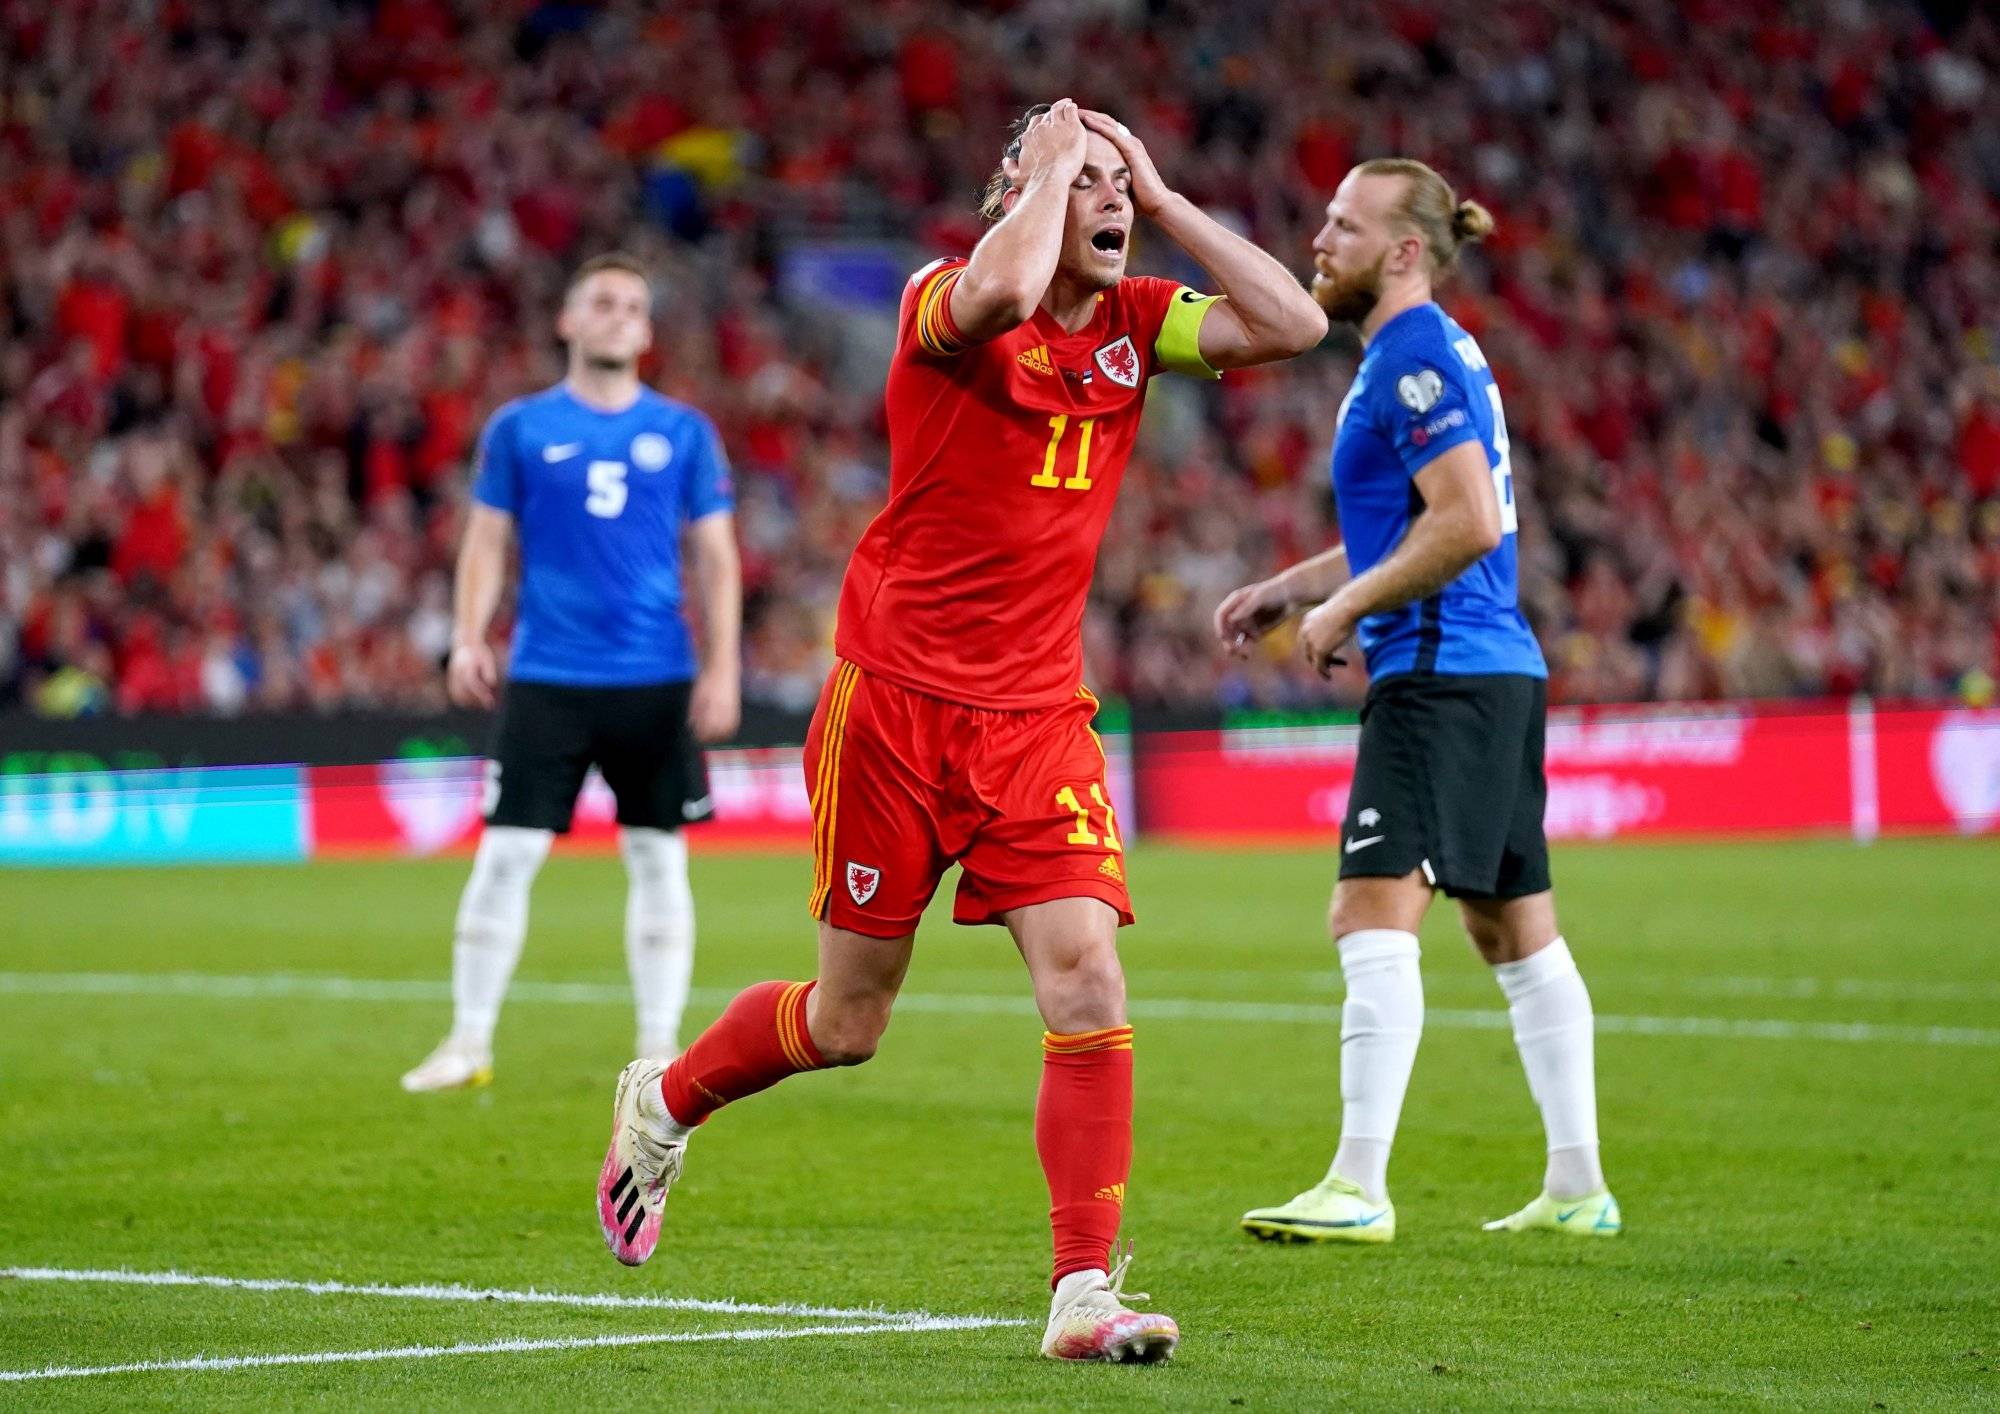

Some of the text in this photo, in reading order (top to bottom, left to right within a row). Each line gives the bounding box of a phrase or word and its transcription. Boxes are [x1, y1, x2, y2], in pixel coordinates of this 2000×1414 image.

[1017, 354, 1054, 376] adidas
[1030, 414, 1095, 490] 11
[584, 459, 629, 520] 5
[1056, 783, 1122, 851] 11
